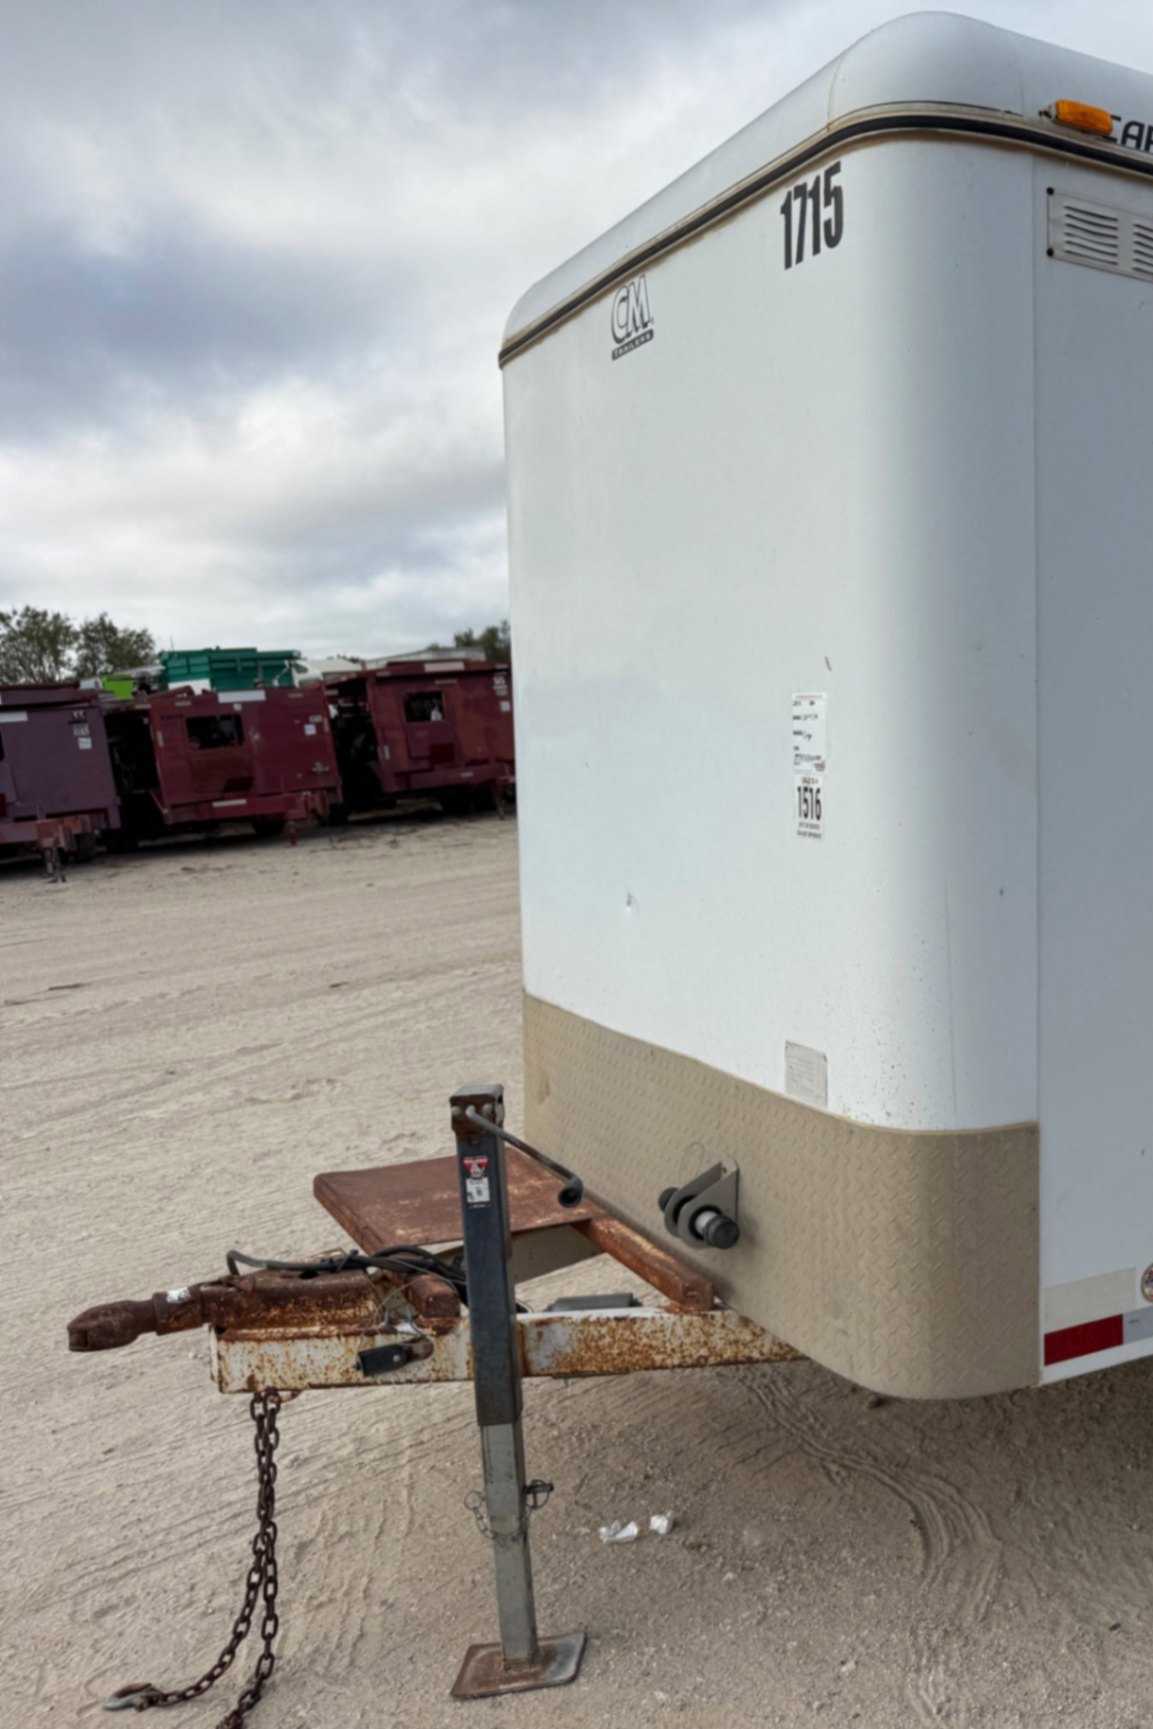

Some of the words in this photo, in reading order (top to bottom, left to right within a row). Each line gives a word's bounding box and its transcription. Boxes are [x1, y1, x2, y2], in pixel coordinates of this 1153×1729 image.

[780, 161, 844, 270] 1715
[611, 274, 651, 345] CM
[797, 786, 822, 821] 1516
